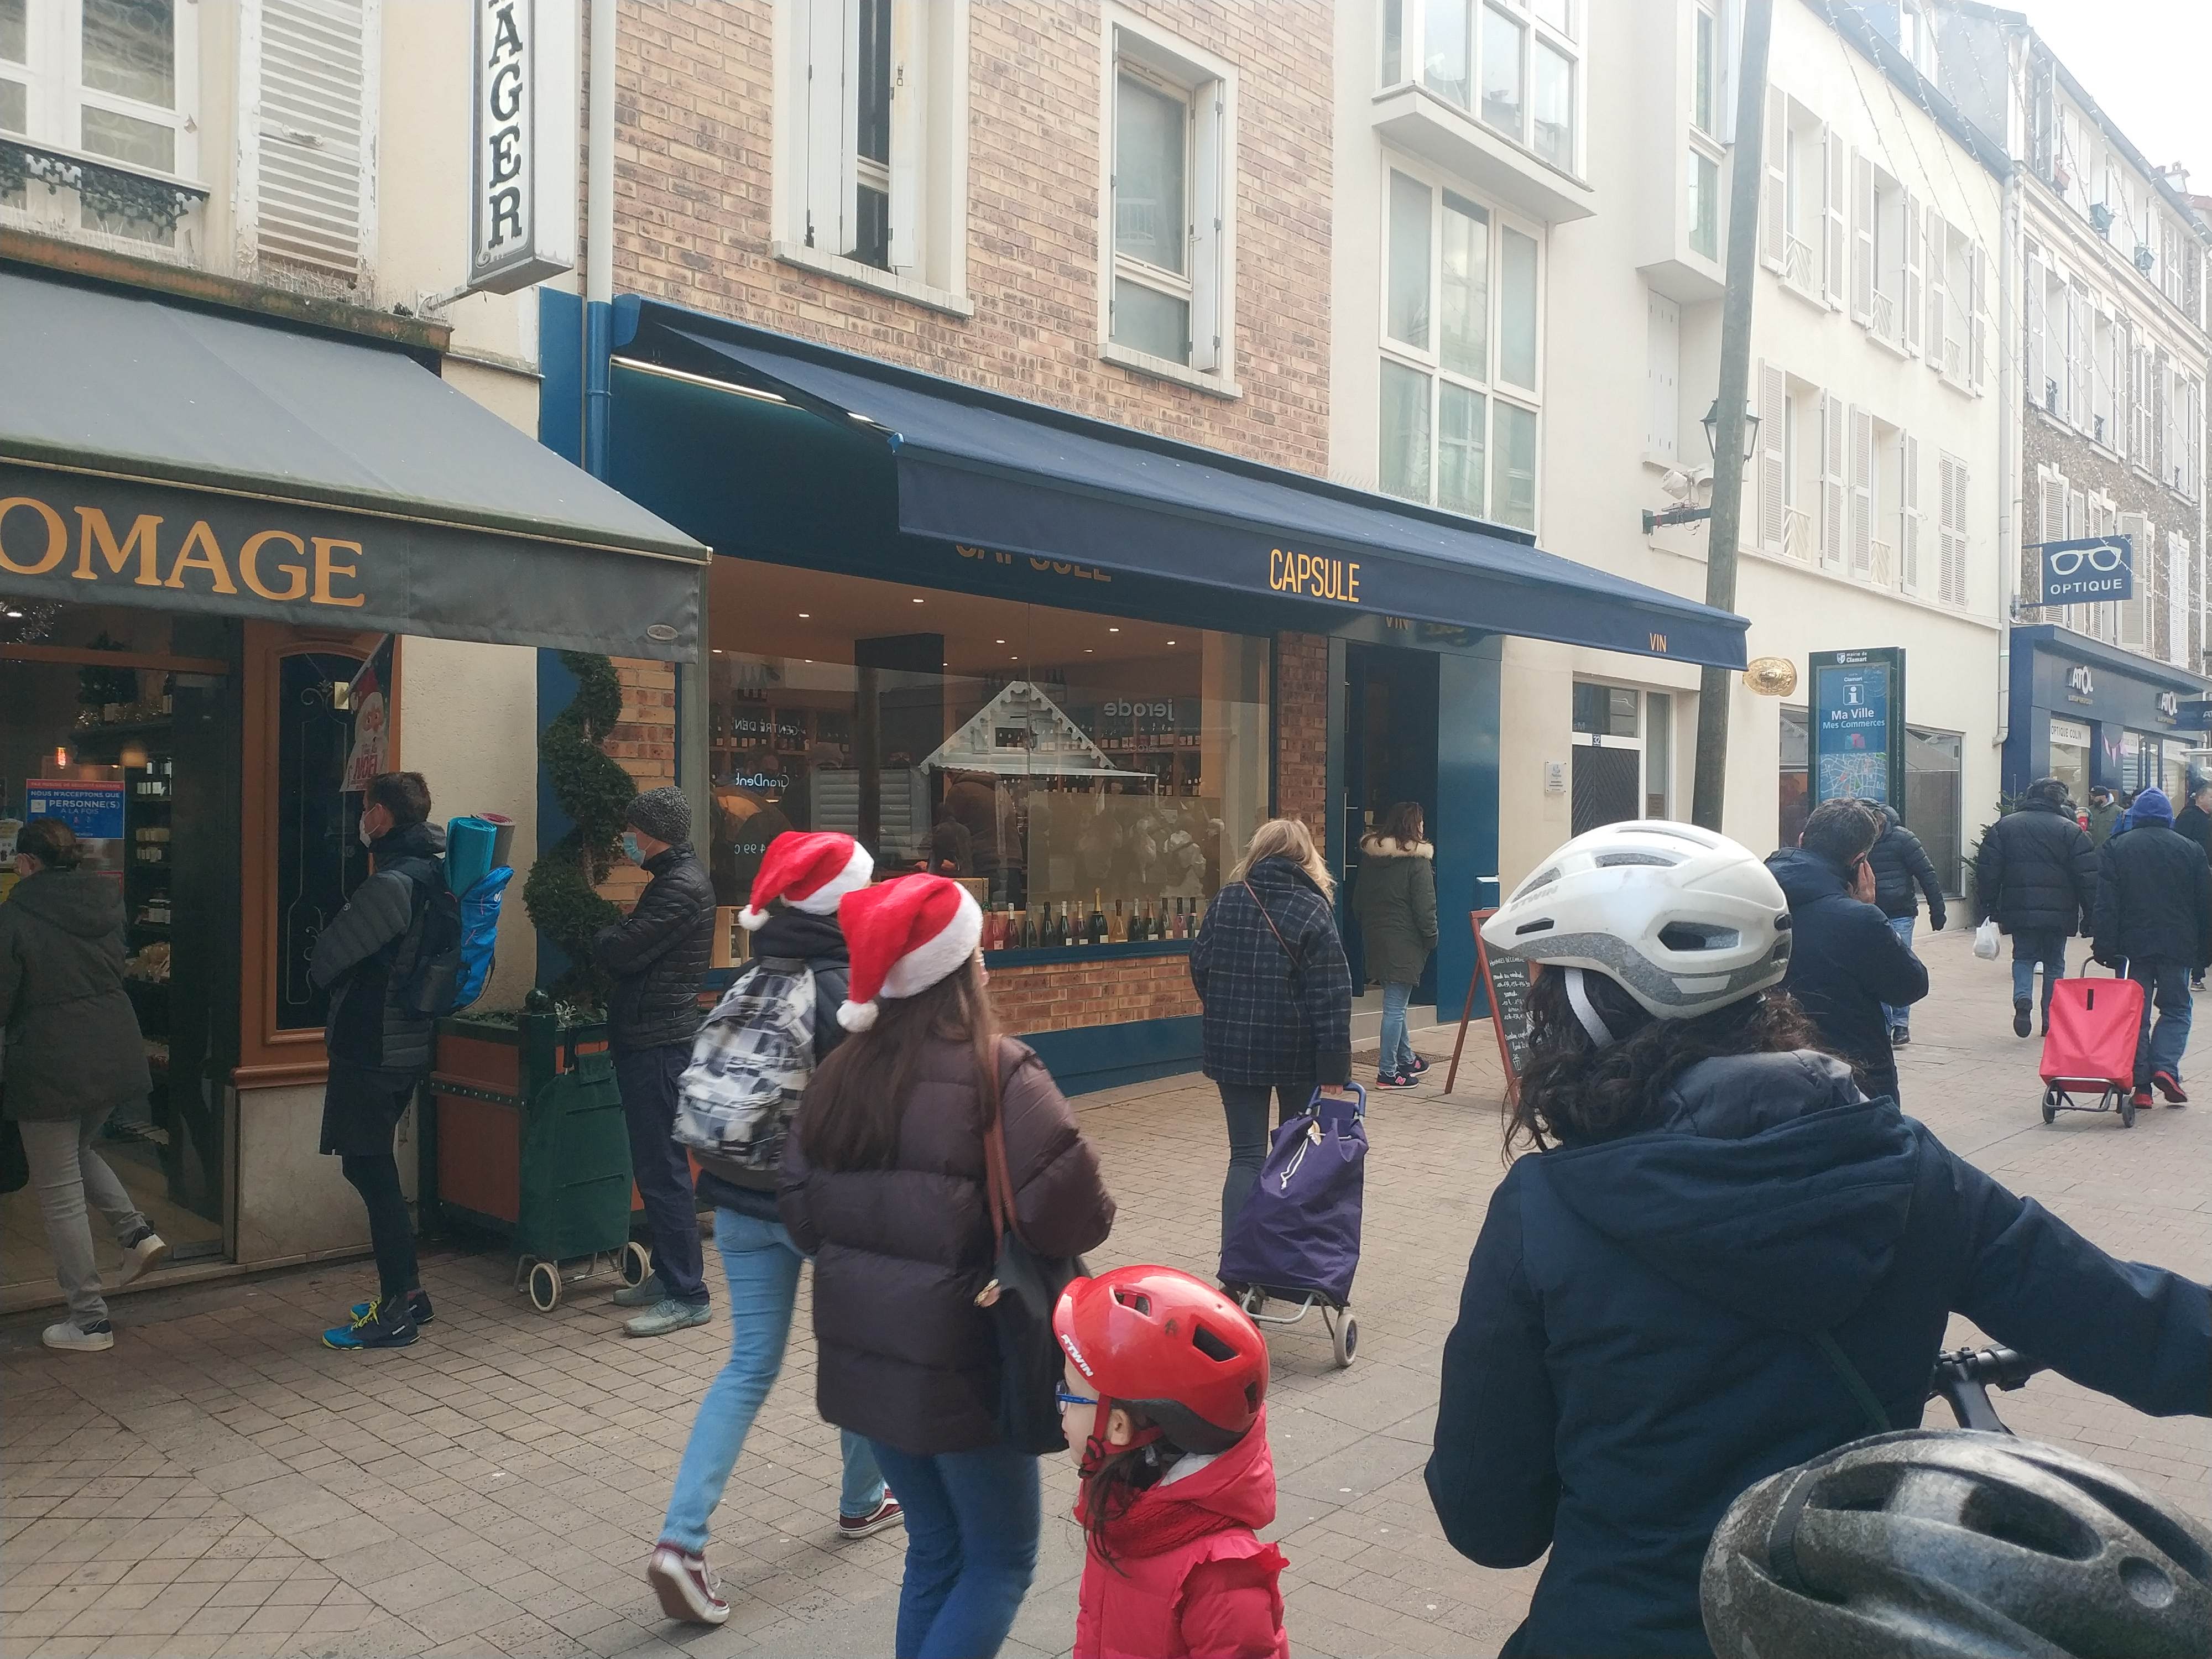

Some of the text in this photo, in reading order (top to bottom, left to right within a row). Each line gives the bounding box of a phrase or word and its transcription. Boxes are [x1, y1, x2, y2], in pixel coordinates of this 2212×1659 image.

[488, 0, 523, 249] AGER
[0, 497, 365, 607] OMAGE
[1269, 549, 1360, 603] CAPSULE
[2050, 578, 2123, 595] OPTIQUE
[1649, 632, 1667, 653] VIN
[1832, 708, 1874, 721] Ma Ville
[1823, 720, 1885, 729] Mes Commerces
[1593, 735, 1600, 745] 32
[49, 800, 120, 810] PERSONNE(S)
